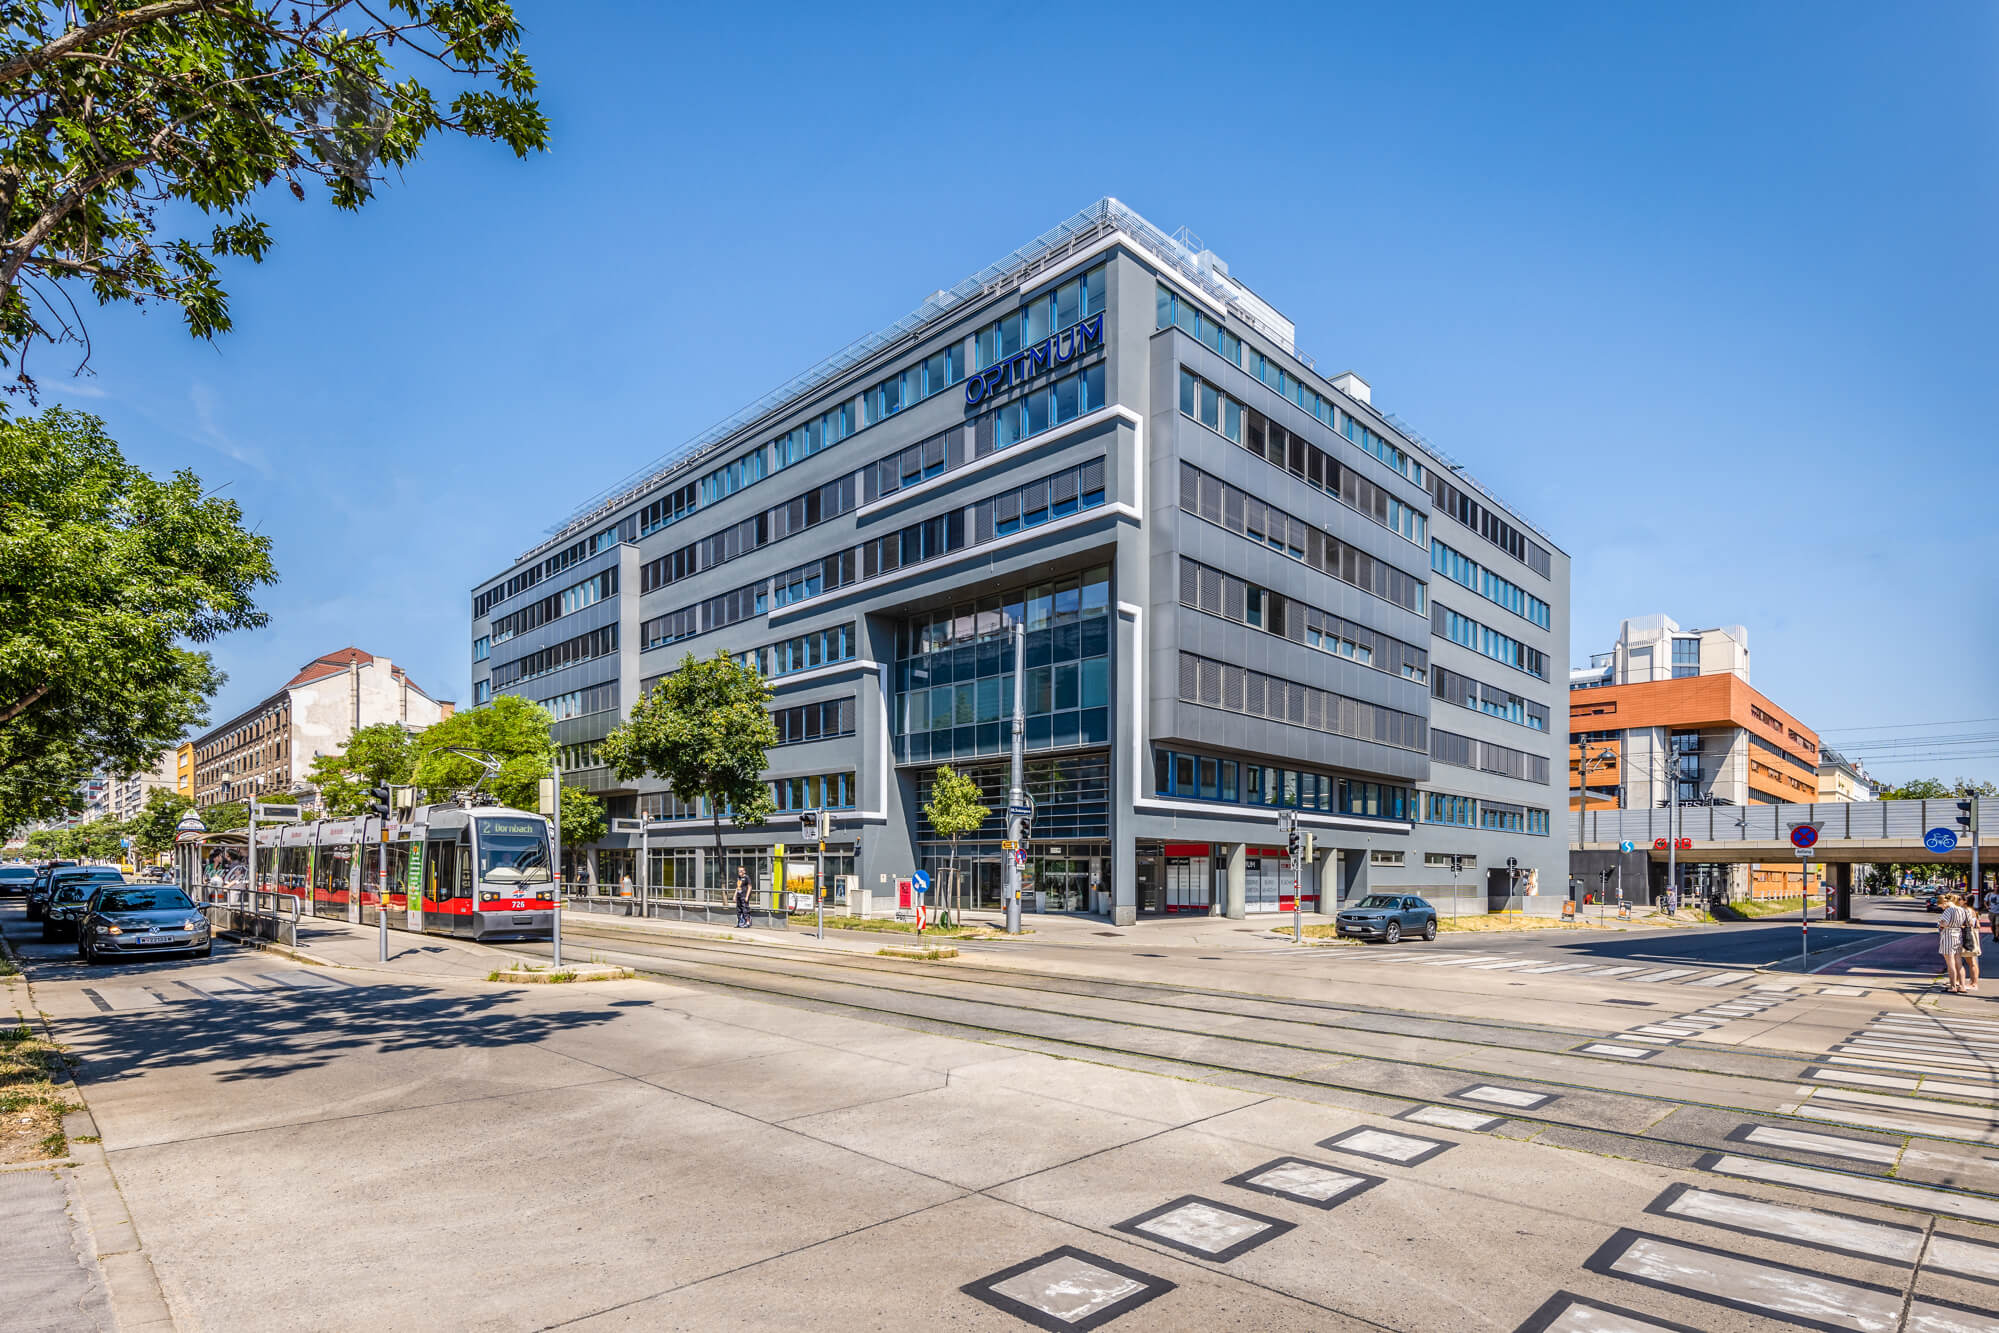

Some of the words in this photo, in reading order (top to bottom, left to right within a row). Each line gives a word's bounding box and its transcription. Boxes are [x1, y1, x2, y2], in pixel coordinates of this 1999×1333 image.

[966, 312, 1104, 404] OPTIMUM
[483, 821, 491, 833] 2
[495, 824, 533, 833] Dornbach
